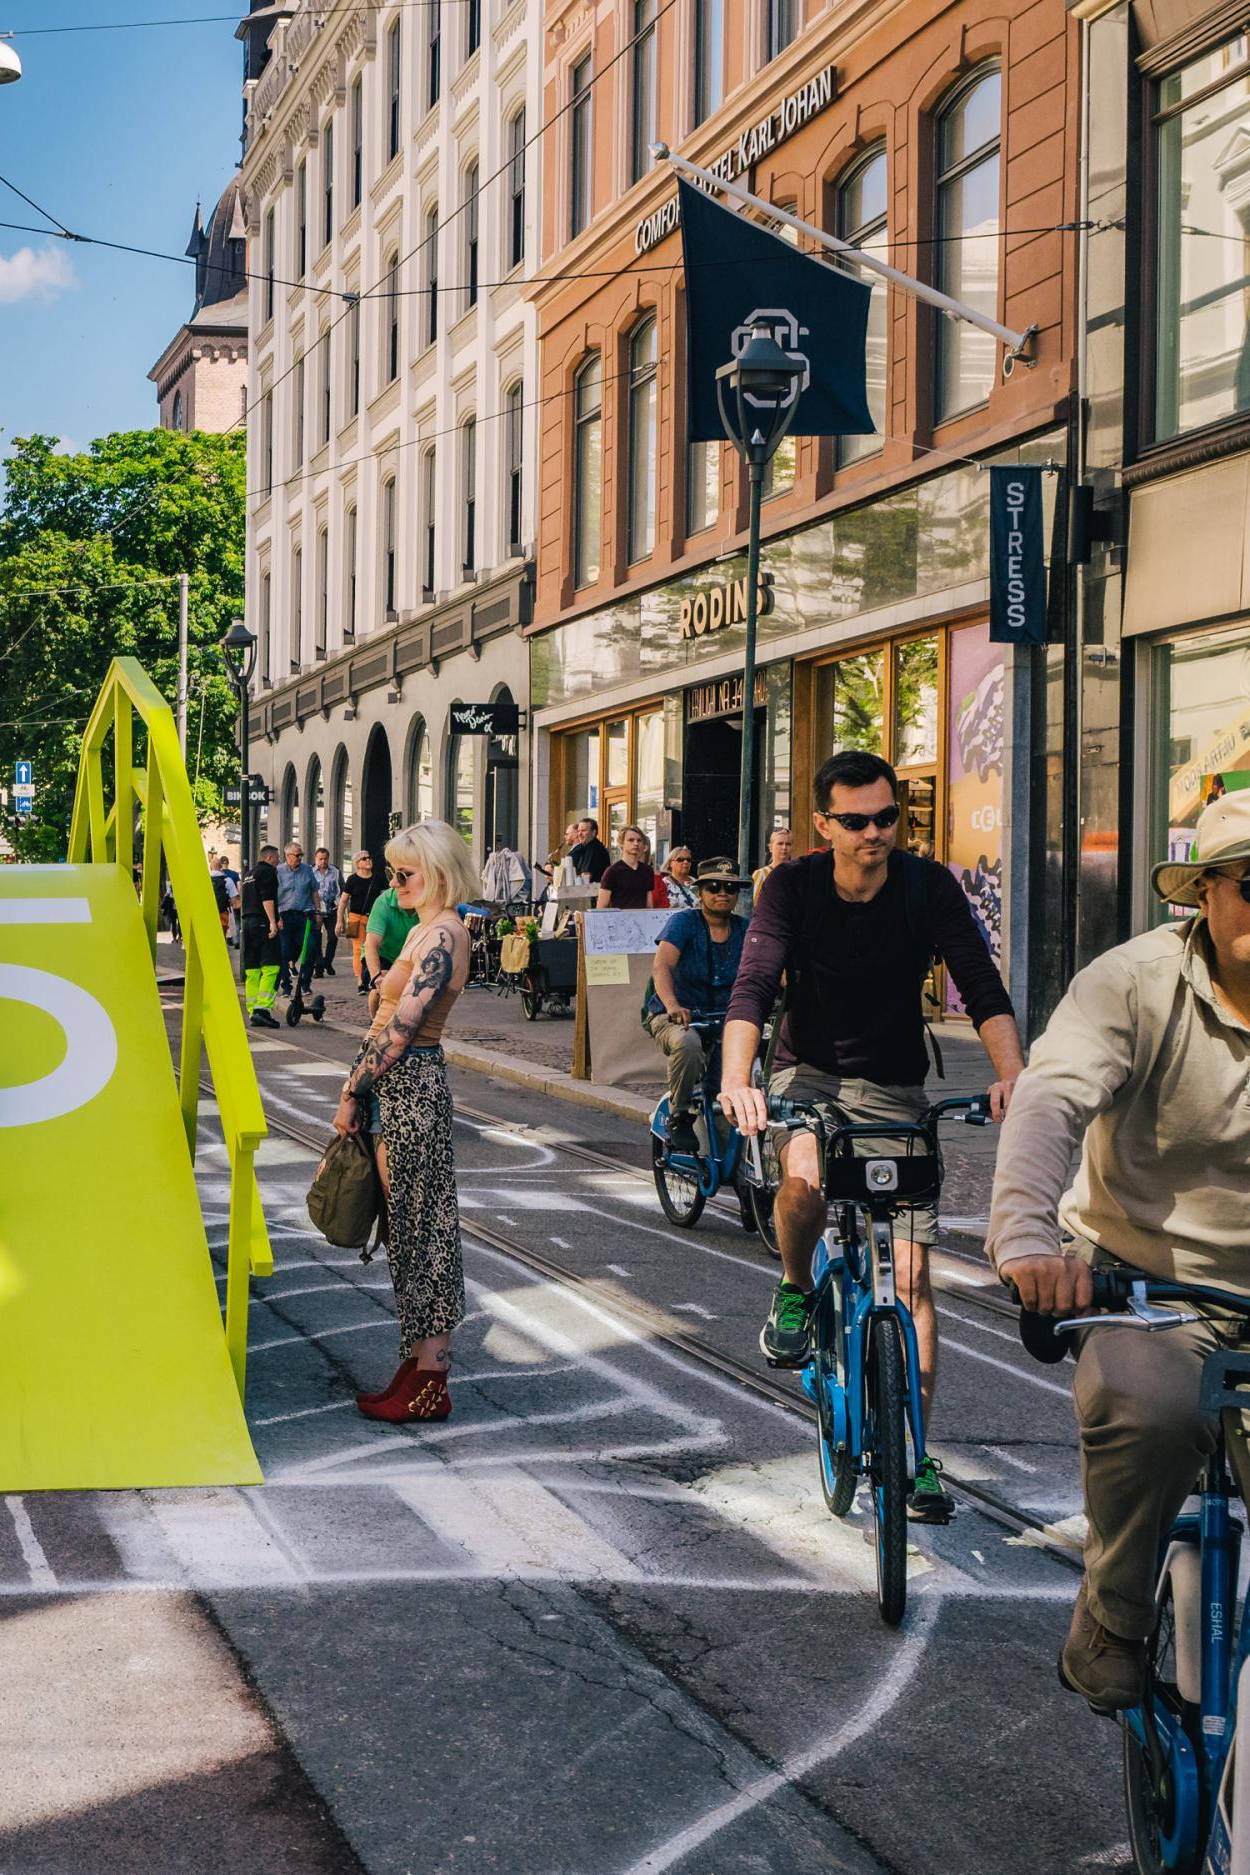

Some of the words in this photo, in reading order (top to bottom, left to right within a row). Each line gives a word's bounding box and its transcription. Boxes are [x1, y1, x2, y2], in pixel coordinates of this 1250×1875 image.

[737, 126, 775, 174] KARL
[777, 65, 832, 139] JOHAN
[1006, 482, 1026, 627] STRESS
